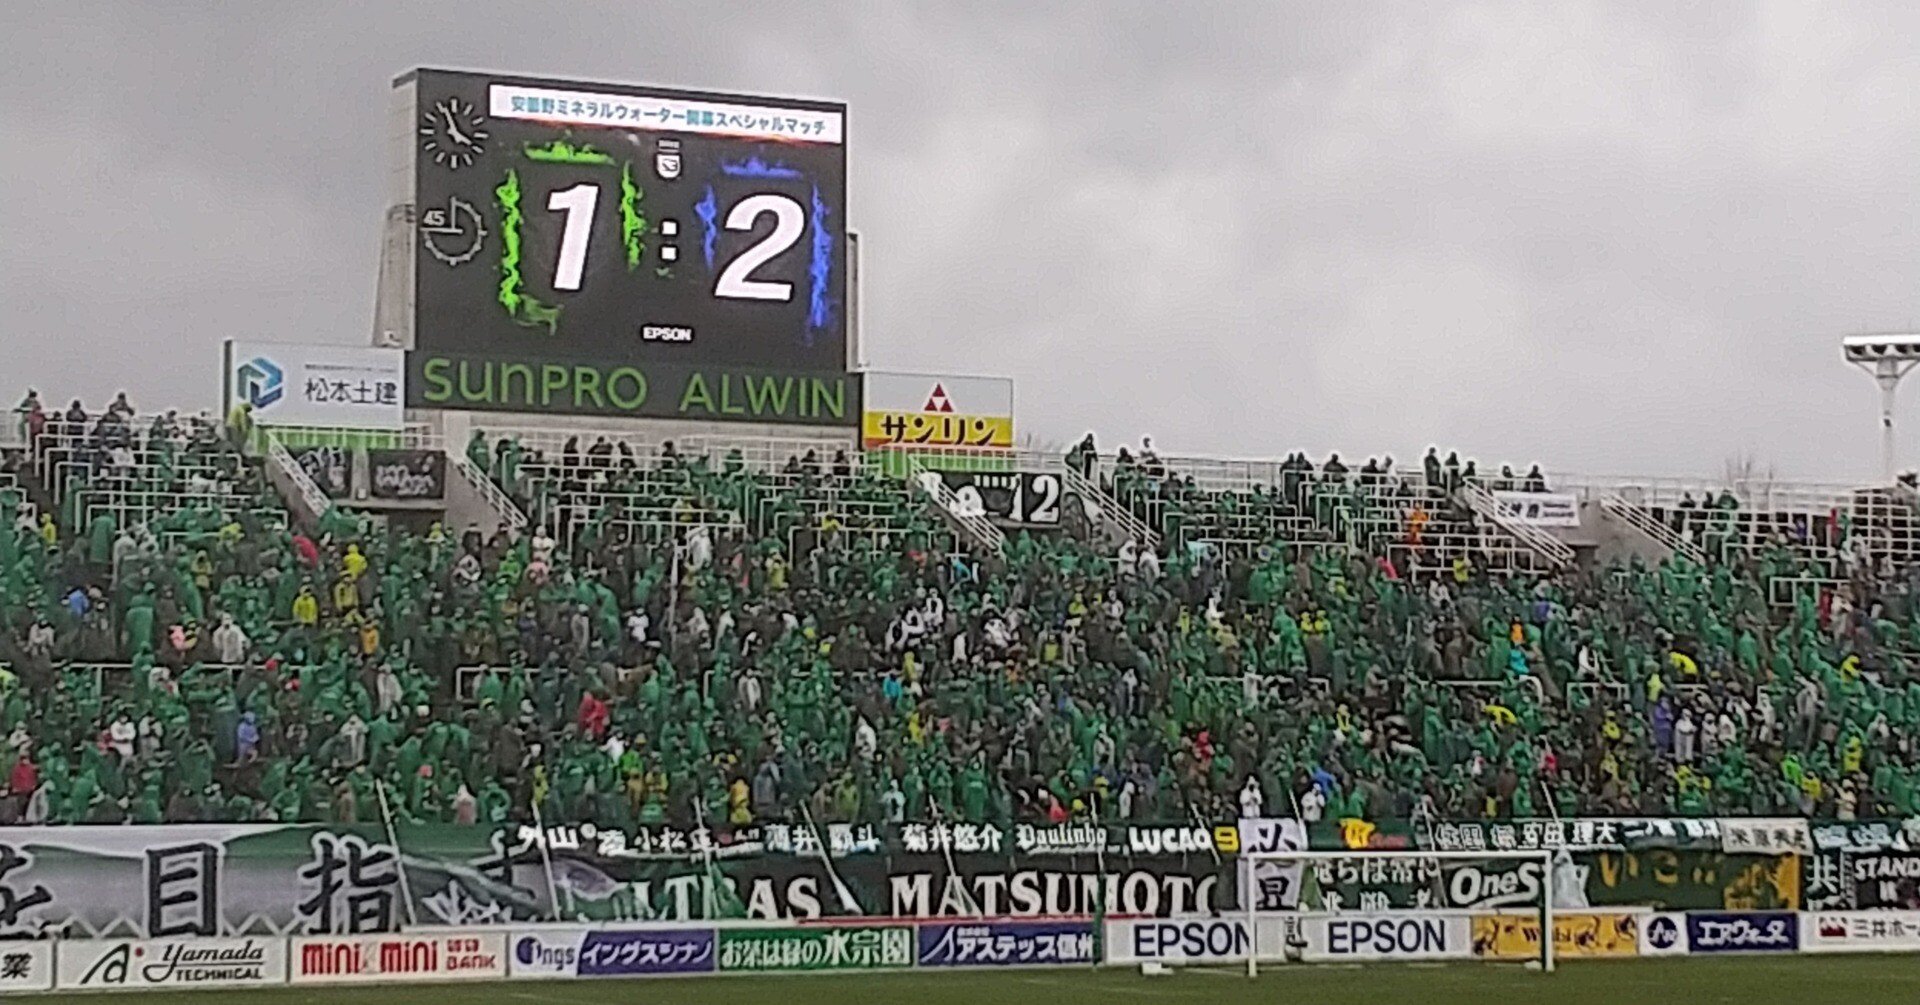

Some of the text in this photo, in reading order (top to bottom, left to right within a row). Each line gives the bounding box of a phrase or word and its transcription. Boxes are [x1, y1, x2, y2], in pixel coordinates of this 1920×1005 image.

[423, 209, 446, 226] 45
[547, 183, 599, 290] 1
[714, 194, 805, 300] 2
[642, 326, 692, 342] EPSON
[304, 377, 398, 405] 松本土建
[679, 374, 845, 418] ALWIN
[880, 415, 998, 446] サンリン
[1134, 924, 1250, 956] EPSON
[1327, 920, 1446, 953] EPSON
[1853, 918, 1920, 937] 三井ホー
[302, 943, 360, 975] mini
[380, 941, 437, 973] mini
[582, 940, 712, 966] イングスシナノ
[176, 969, 263, 982] TECHNICAL
